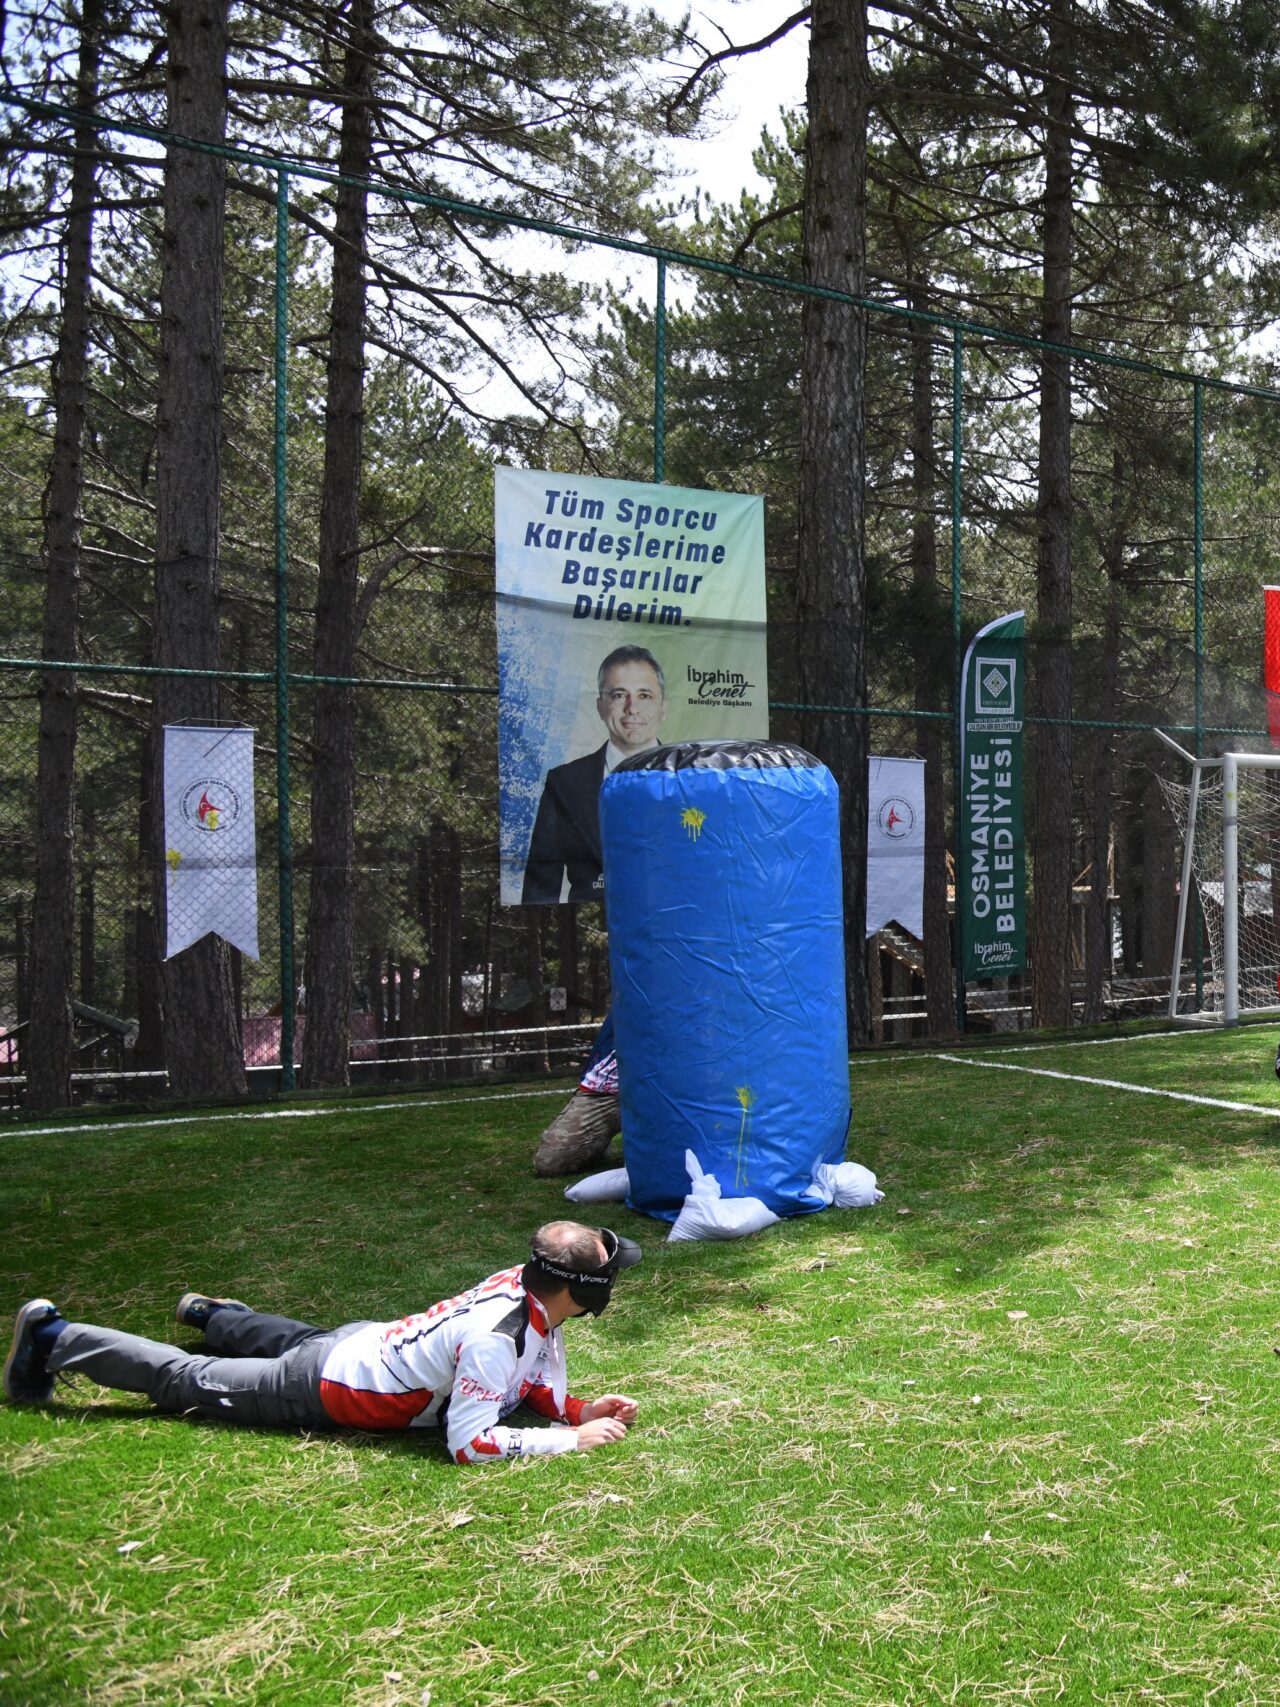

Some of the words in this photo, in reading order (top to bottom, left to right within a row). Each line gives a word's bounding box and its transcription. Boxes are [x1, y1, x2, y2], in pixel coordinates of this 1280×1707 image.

[545, 490, 605, 520] Tüm
[616, 498, 718, 532] Sporcu
[524, 521, 726, 564] Kardeşlerime
[561, 559, 703, 594] Başarılar
[573, 594, 692, 627] Dilerim.
[687, 664, 744, 684] İbrahim
[688, 698, 720, 706] Belediye
[722, 699, 752, 708] Başkanı
[966, 754, 991, 918] OSMANİYE
[989, 738, 1016, 932] BELEDİYESİ
[541, 1261, 577, 1280] VFORCE
[580, 1273, 609, 1284] VFORCE
